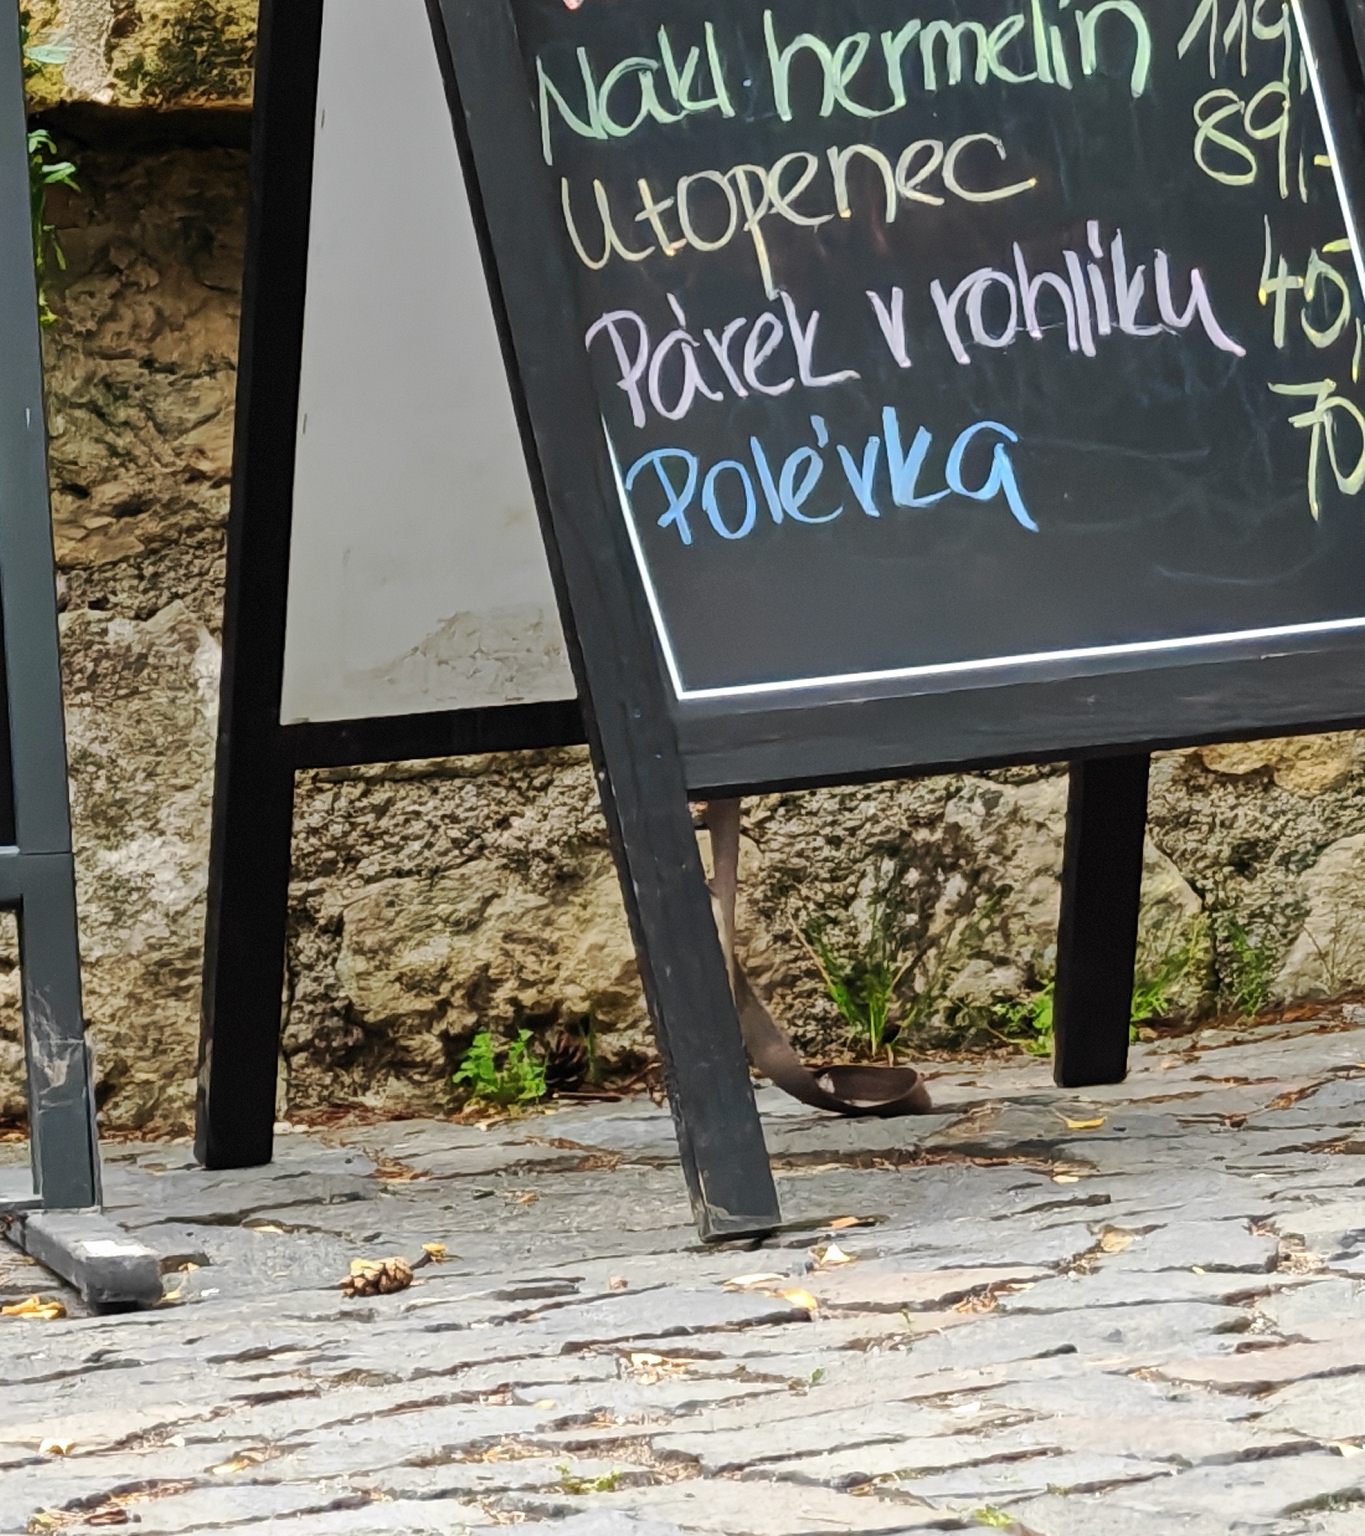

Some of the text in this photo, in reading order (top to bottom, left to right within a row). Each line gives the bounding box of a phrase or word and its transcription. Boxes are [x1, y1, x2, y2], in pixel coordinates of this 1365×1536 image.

[561, 132, 1038, 297] Utopenec
[584, 291, 860, 429] Párek
[930, 219, 1247, 366] rohlíku
[625, 405, 1040, 546] Polévka
